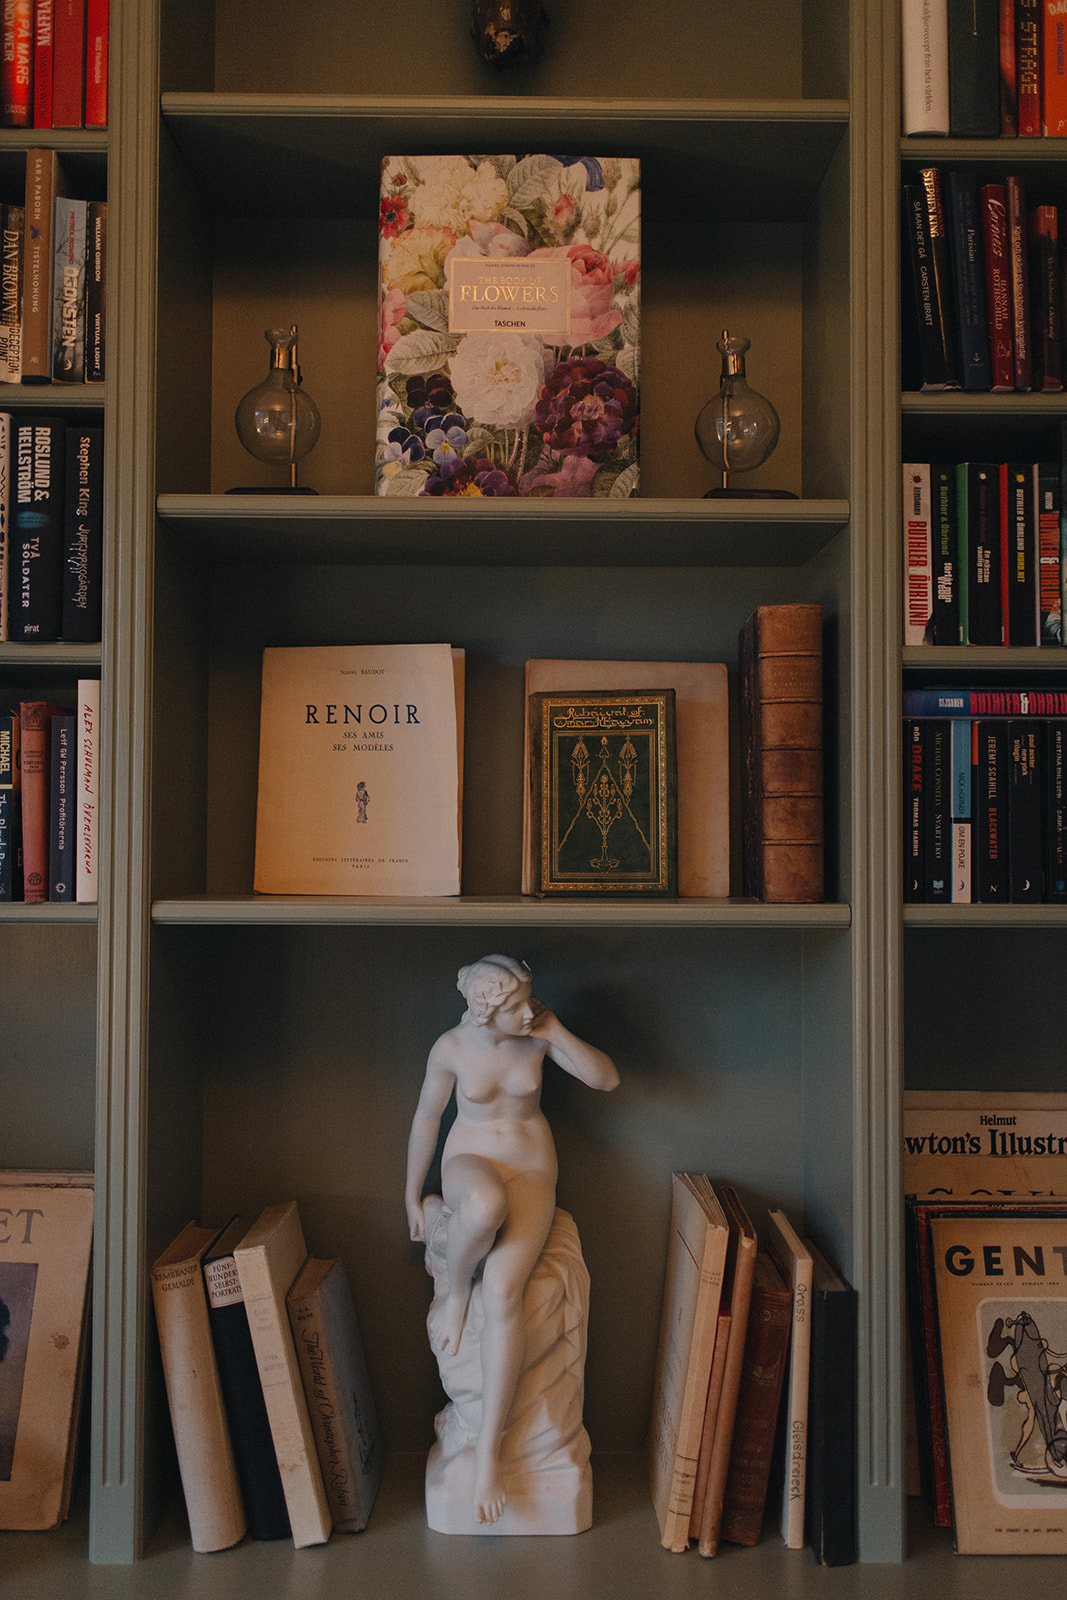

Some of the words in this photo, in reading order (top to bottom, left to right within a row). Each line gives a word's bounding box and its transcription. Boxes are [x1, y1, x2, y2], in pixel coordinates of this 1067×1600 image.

[17, 18, 32, 38] PÅ
[4, 31, 15, 61] WEIR
[1021, 21, 1038, 95] STRAGE
[16, 42, 30, 85] MARS
[34, 158, 42, 183] SARA
[33, 185, 42, 220] PABORN
[922, 170, 937, 212] STEPHEN
[913, 201, 925, 212] SÅ
[914, 212, 924, 229] KAN
[94, 217, 102, 250] WILLIAM
[916, 231, 926, 247] DET
[928, 213, 940, 238] KING
[2, 230, 20, 258] DAN
[917, 247, 929, 259] GÅ
[966, 229, 977, 262] Parisian
[31, 246, 41, 313] TISTELHONUNG
[94, 253, 102, 282] GIBSON
[500, 276, 525, 286] BOOK
[1, 262, 19, 312] BROWN
[460, 285, 560, 303] FLOWERS
[919, 266, 931, 302] CARSTEN
[992, 268, 1004, 331] ROTHSCHILD
[1000, 279, 1009, 321] HANNAH
[1016, 284, 1025, 320] Stockholms
[94, 313, 102, 345] VIRTUAL
[494, 320, 526, 328] TASCHEN
[923, 302, 934, 327] BRATT
[8, 327, 20, 375] DECEPTION
[94, 347, 102, 369] LIGHT
[17, 426, 34, 503] HELLSTRÖM
[34, 426, 51, 488] ROSLUND
[76, 436, 91, 485] Stephen
[33, 489, 51, 502] &
[75, 487, 91, 517] King
[1016, 488, 1025, 515] BUTHLER
[30, 536, 41, 558] TVÅ
[908, 521, 928, 567] BUTHLER
[1016, 522, 1026, 551] ÖHRLUND
[1039, 513, 1060, 557] BUTHLER
[21, 543, 30, 608] SOLDATER
[908, 574, 931, 626] ÖHRLUND
[23, 623, 40, 633] pirat
[305, 704, 420, 724] RENOIR
[969, 692, 1020, 714] BUTHLER
[1020, 692, 1029, 714] &
[83, 704, 93, 734] ALEX
[59, 728, 67, 745] Leif
[353, 742, 394, 752] MODÈLES
[912, 726, 921, 742] RÖD
[1027, 734, 1036, 748] paul
[1055, 731, 1063, 766] KRISTINA
[0, 730, 11, 775] MICHAEL
[59, 747, 67, 758] GW
[987, 735, 997, 764] JEREMY
[1012, 739, 1022, 762] trilogin
[1021, 748, 1029, 761] new
[58, 760, 67, 793] Persson
[82, 738, 93, 794] SCHULMAN
[911, 744, 922, 792] DRAKE
[958, 772, 966, 787] NICK
[1020, 761, 1029, 776] york
[987, 766, 997, 800] SCAHILL
[912, 797, 920, 827] THOMAS
[958, 788, 966, 815] HORNBY
[58, 798, 67, 850] Profitörerna
[988, 807, 998, 859] BLACKWATER
[912, 830, 920, 857] HARRIS
[980, 1115, 1017, 1126] Helmut
[904, 1132, 982, 1155] wton's
[154, 1264, 198, 1281] REMBRANDT
[208, 1269, 239, 1282] HUNDER
[796, 1283, 808, 1323] Grass
[299, 1327, 322, 1355] The
[307, 1350, 328, 1386] World
[313, 1387, 328, 1401] of
[316, 1401, 344, 1465] Christopher
[790, 1420, 805, 1502] Gleisdreieck
[326, 1463, 352, 1508] Robin
